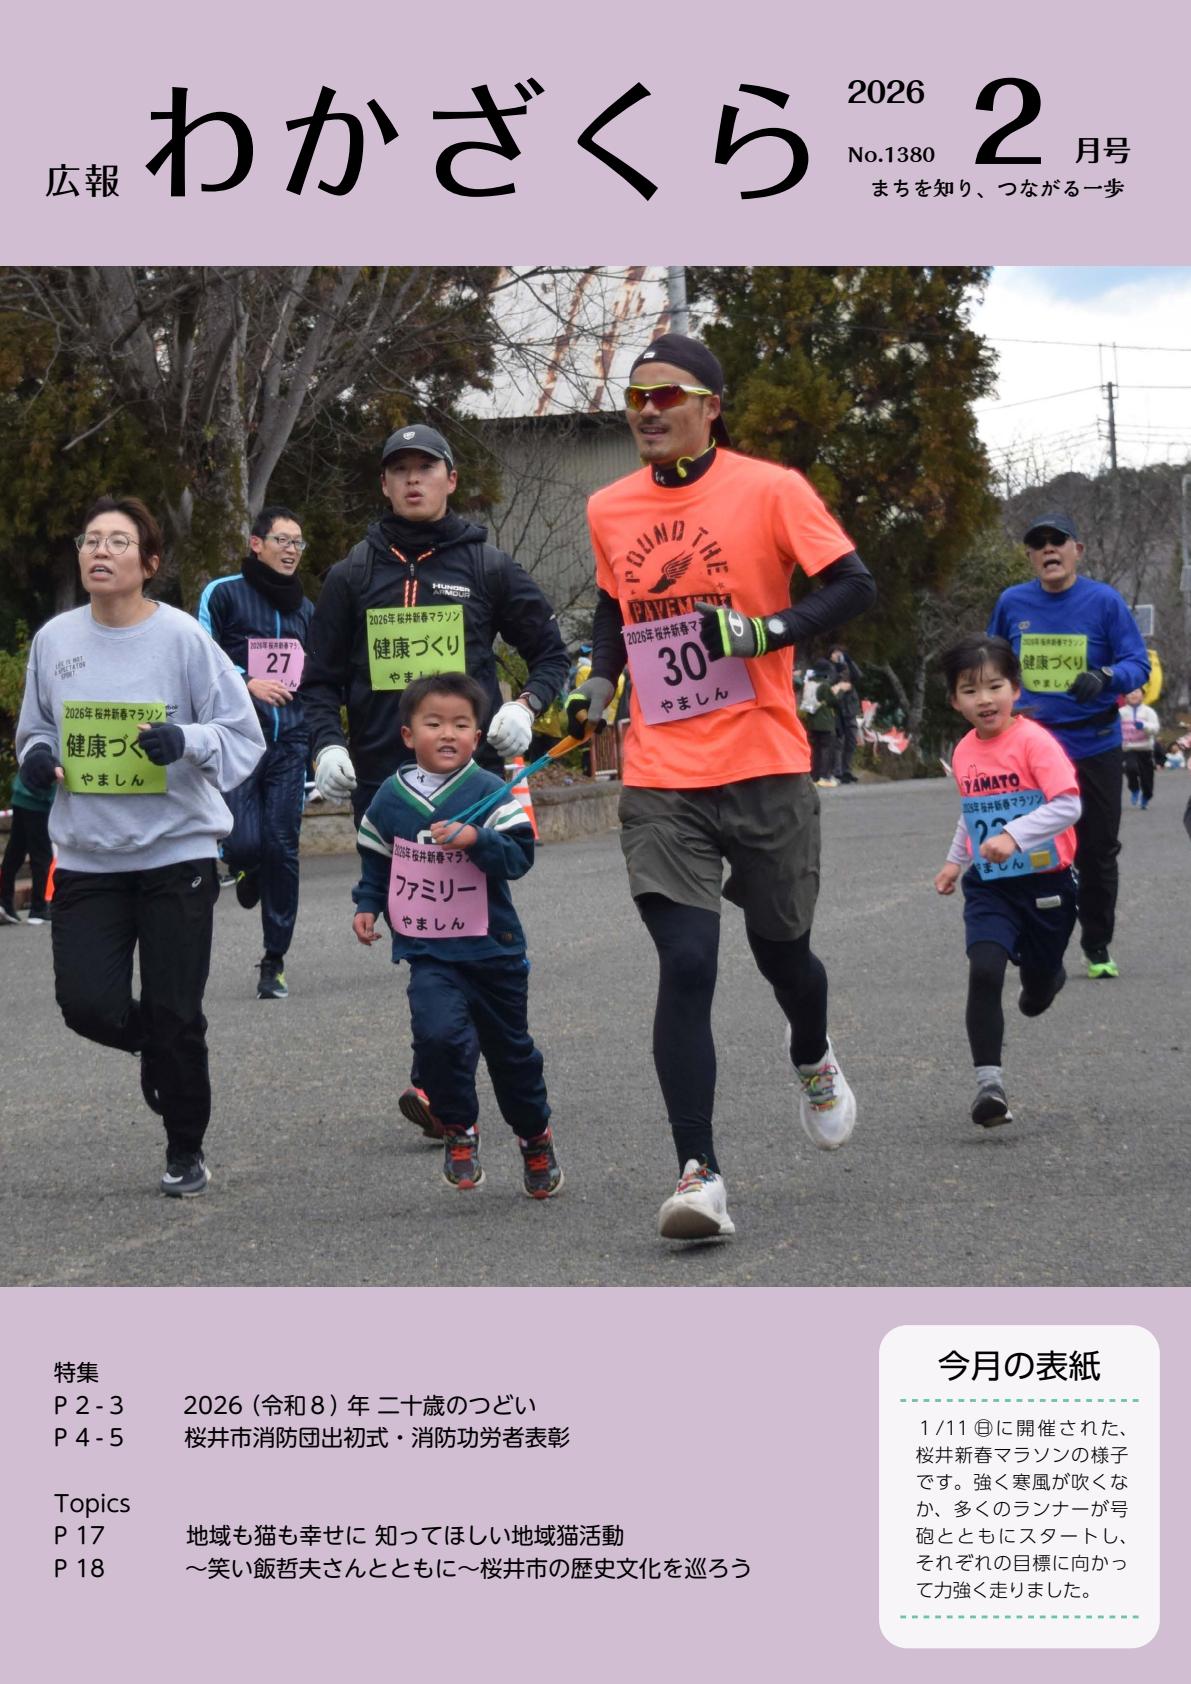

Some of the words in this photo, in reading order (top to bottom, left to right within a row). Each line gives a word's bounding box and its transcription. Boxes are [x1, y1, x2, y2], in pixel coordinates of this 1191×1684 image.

[625, 520, 685, 583] POUND
[690, 527, 729, 576] THE
[369, 613, 396, 626] 2026年
[626, 627, 655, 645] 2026年
[654, 620, 702, 642] 桜井新春マ
[373, 635, 459, 660] 健康づくり
[266, 652, 291, 673] 27
[1023, 654, 1083, 670] 健康づくり
[661, 688, 729, 714] やましん
[65, 707, 93, 720] 2026年
[95, 707, 162, 721] 桜井新春マラソン
[67, 733, 143, 759] 健康づく
[81, 773, 144, 786] やましん
[964, 773, 1020, 793] YAMATO
[412, 847, 470, 864] 桜井新春マラ
[396, 875, 477, 902] ファミリー
[402, 915, 465, 931] やましん
